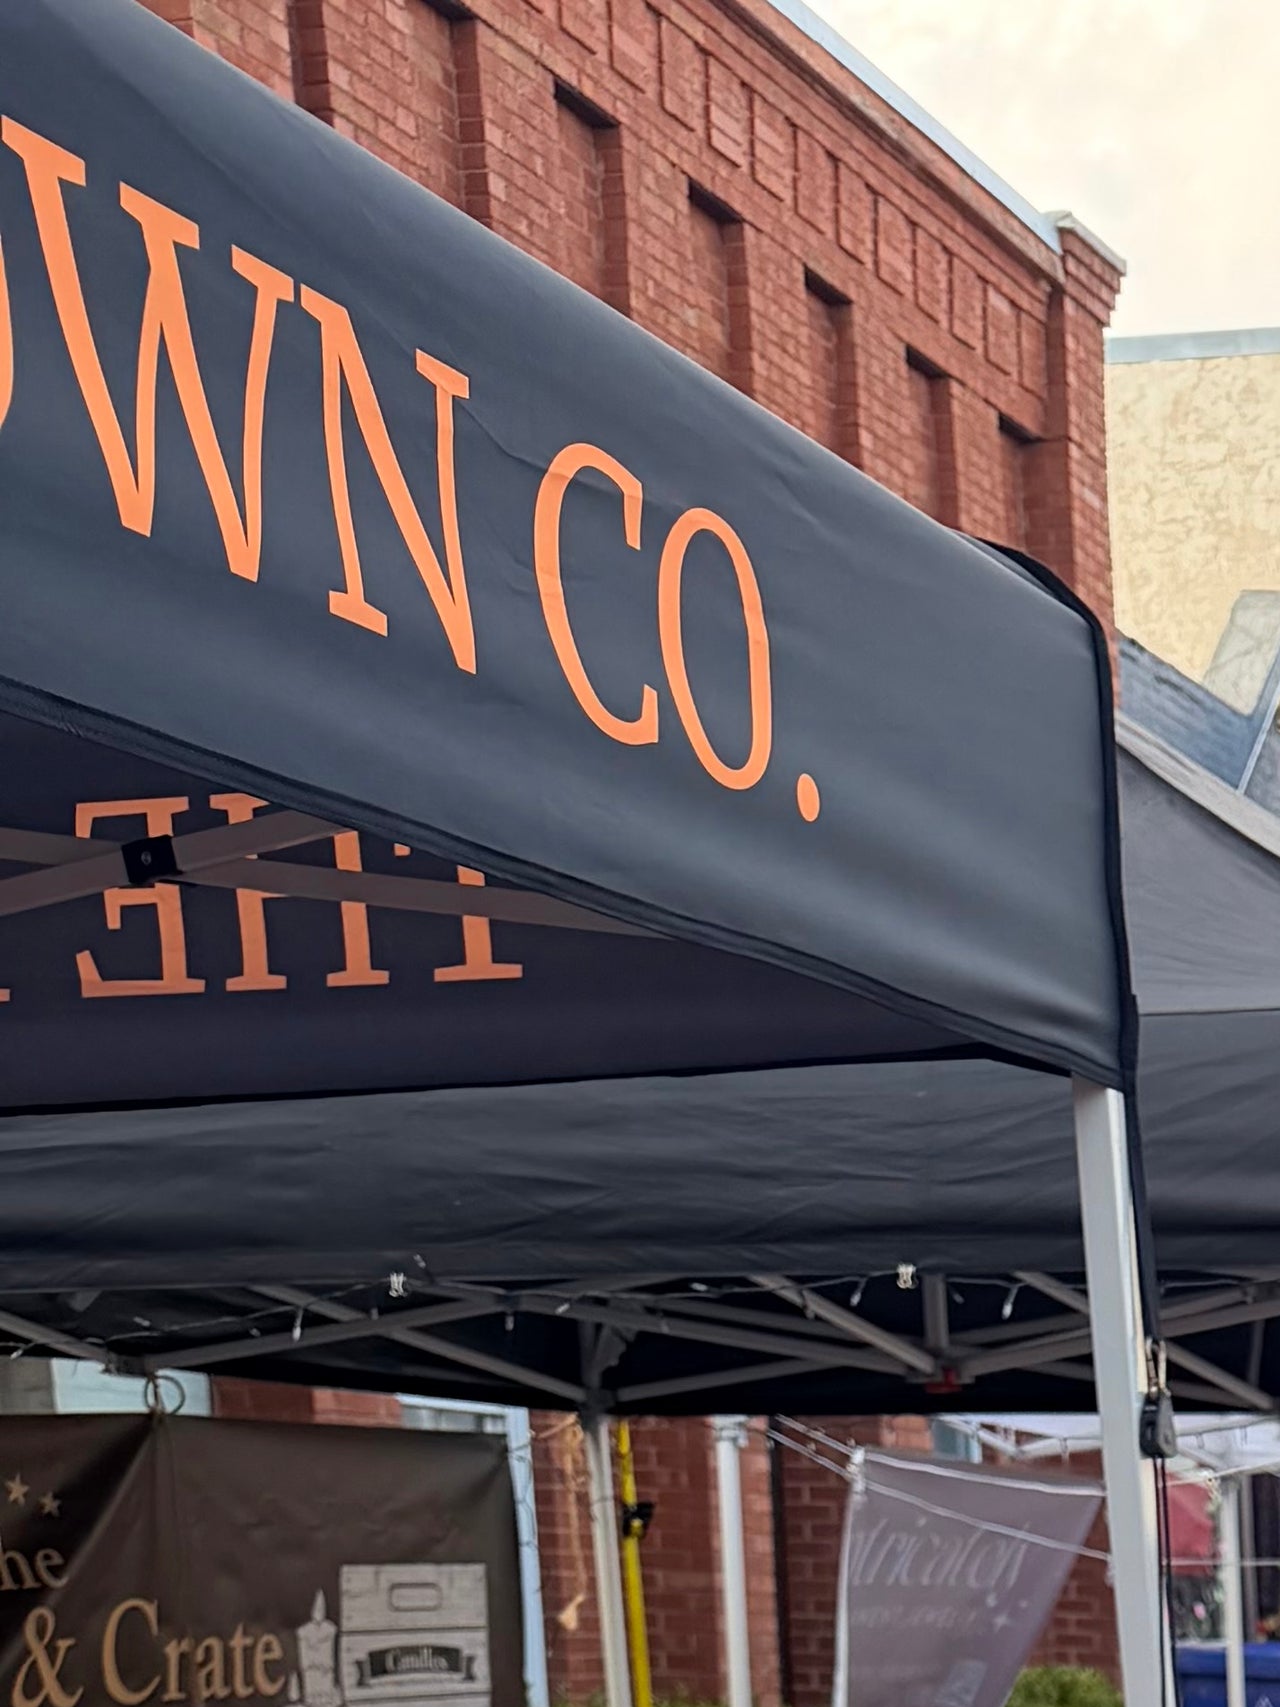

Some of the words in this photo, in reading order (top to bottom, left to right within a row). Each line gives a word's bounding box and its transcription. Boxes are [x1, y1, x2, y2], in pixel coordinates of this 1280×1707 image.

[0, 115, 476, 675] WN
[533, 442, 820, 822] CO.
[102, 1597, 287, 1707] Crate
